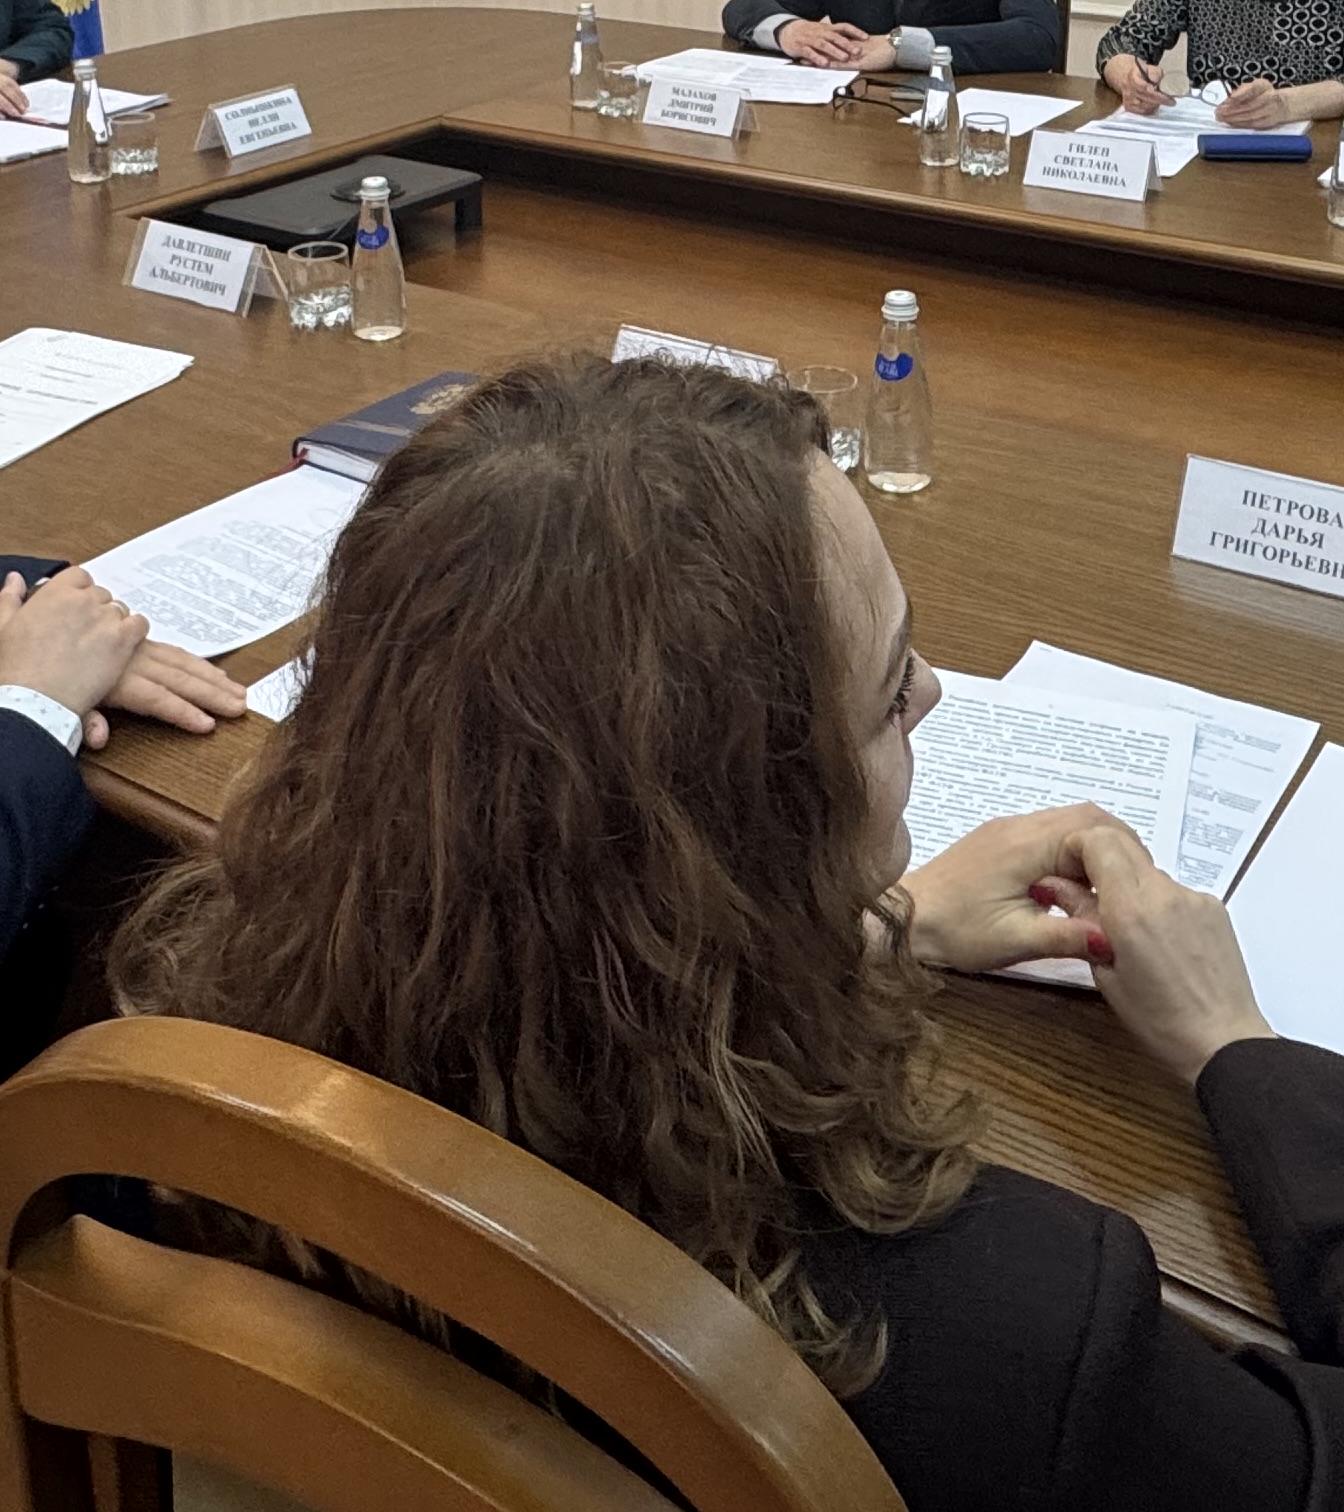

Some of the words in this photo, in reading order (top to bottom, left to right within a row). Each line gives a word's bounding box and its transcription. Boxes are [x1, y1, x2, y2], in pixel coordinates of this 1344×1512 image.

[1042, 165, 1127, 187] НИКОЛАЕВНА
[1053, 154, 1119, 172] СВЕТЛАНА
[160, 235, 232, 262] ДАВЛЕТШИН
[169, 253, 214, 275] РУСТЕМ
[148, 266, 227, 296] АЛЬБЕРТОВИЧ
[1241, 489, 1344, 529] ПЕТРОВА
[1250, 517, 1326, 549] ДАРЬЯ
